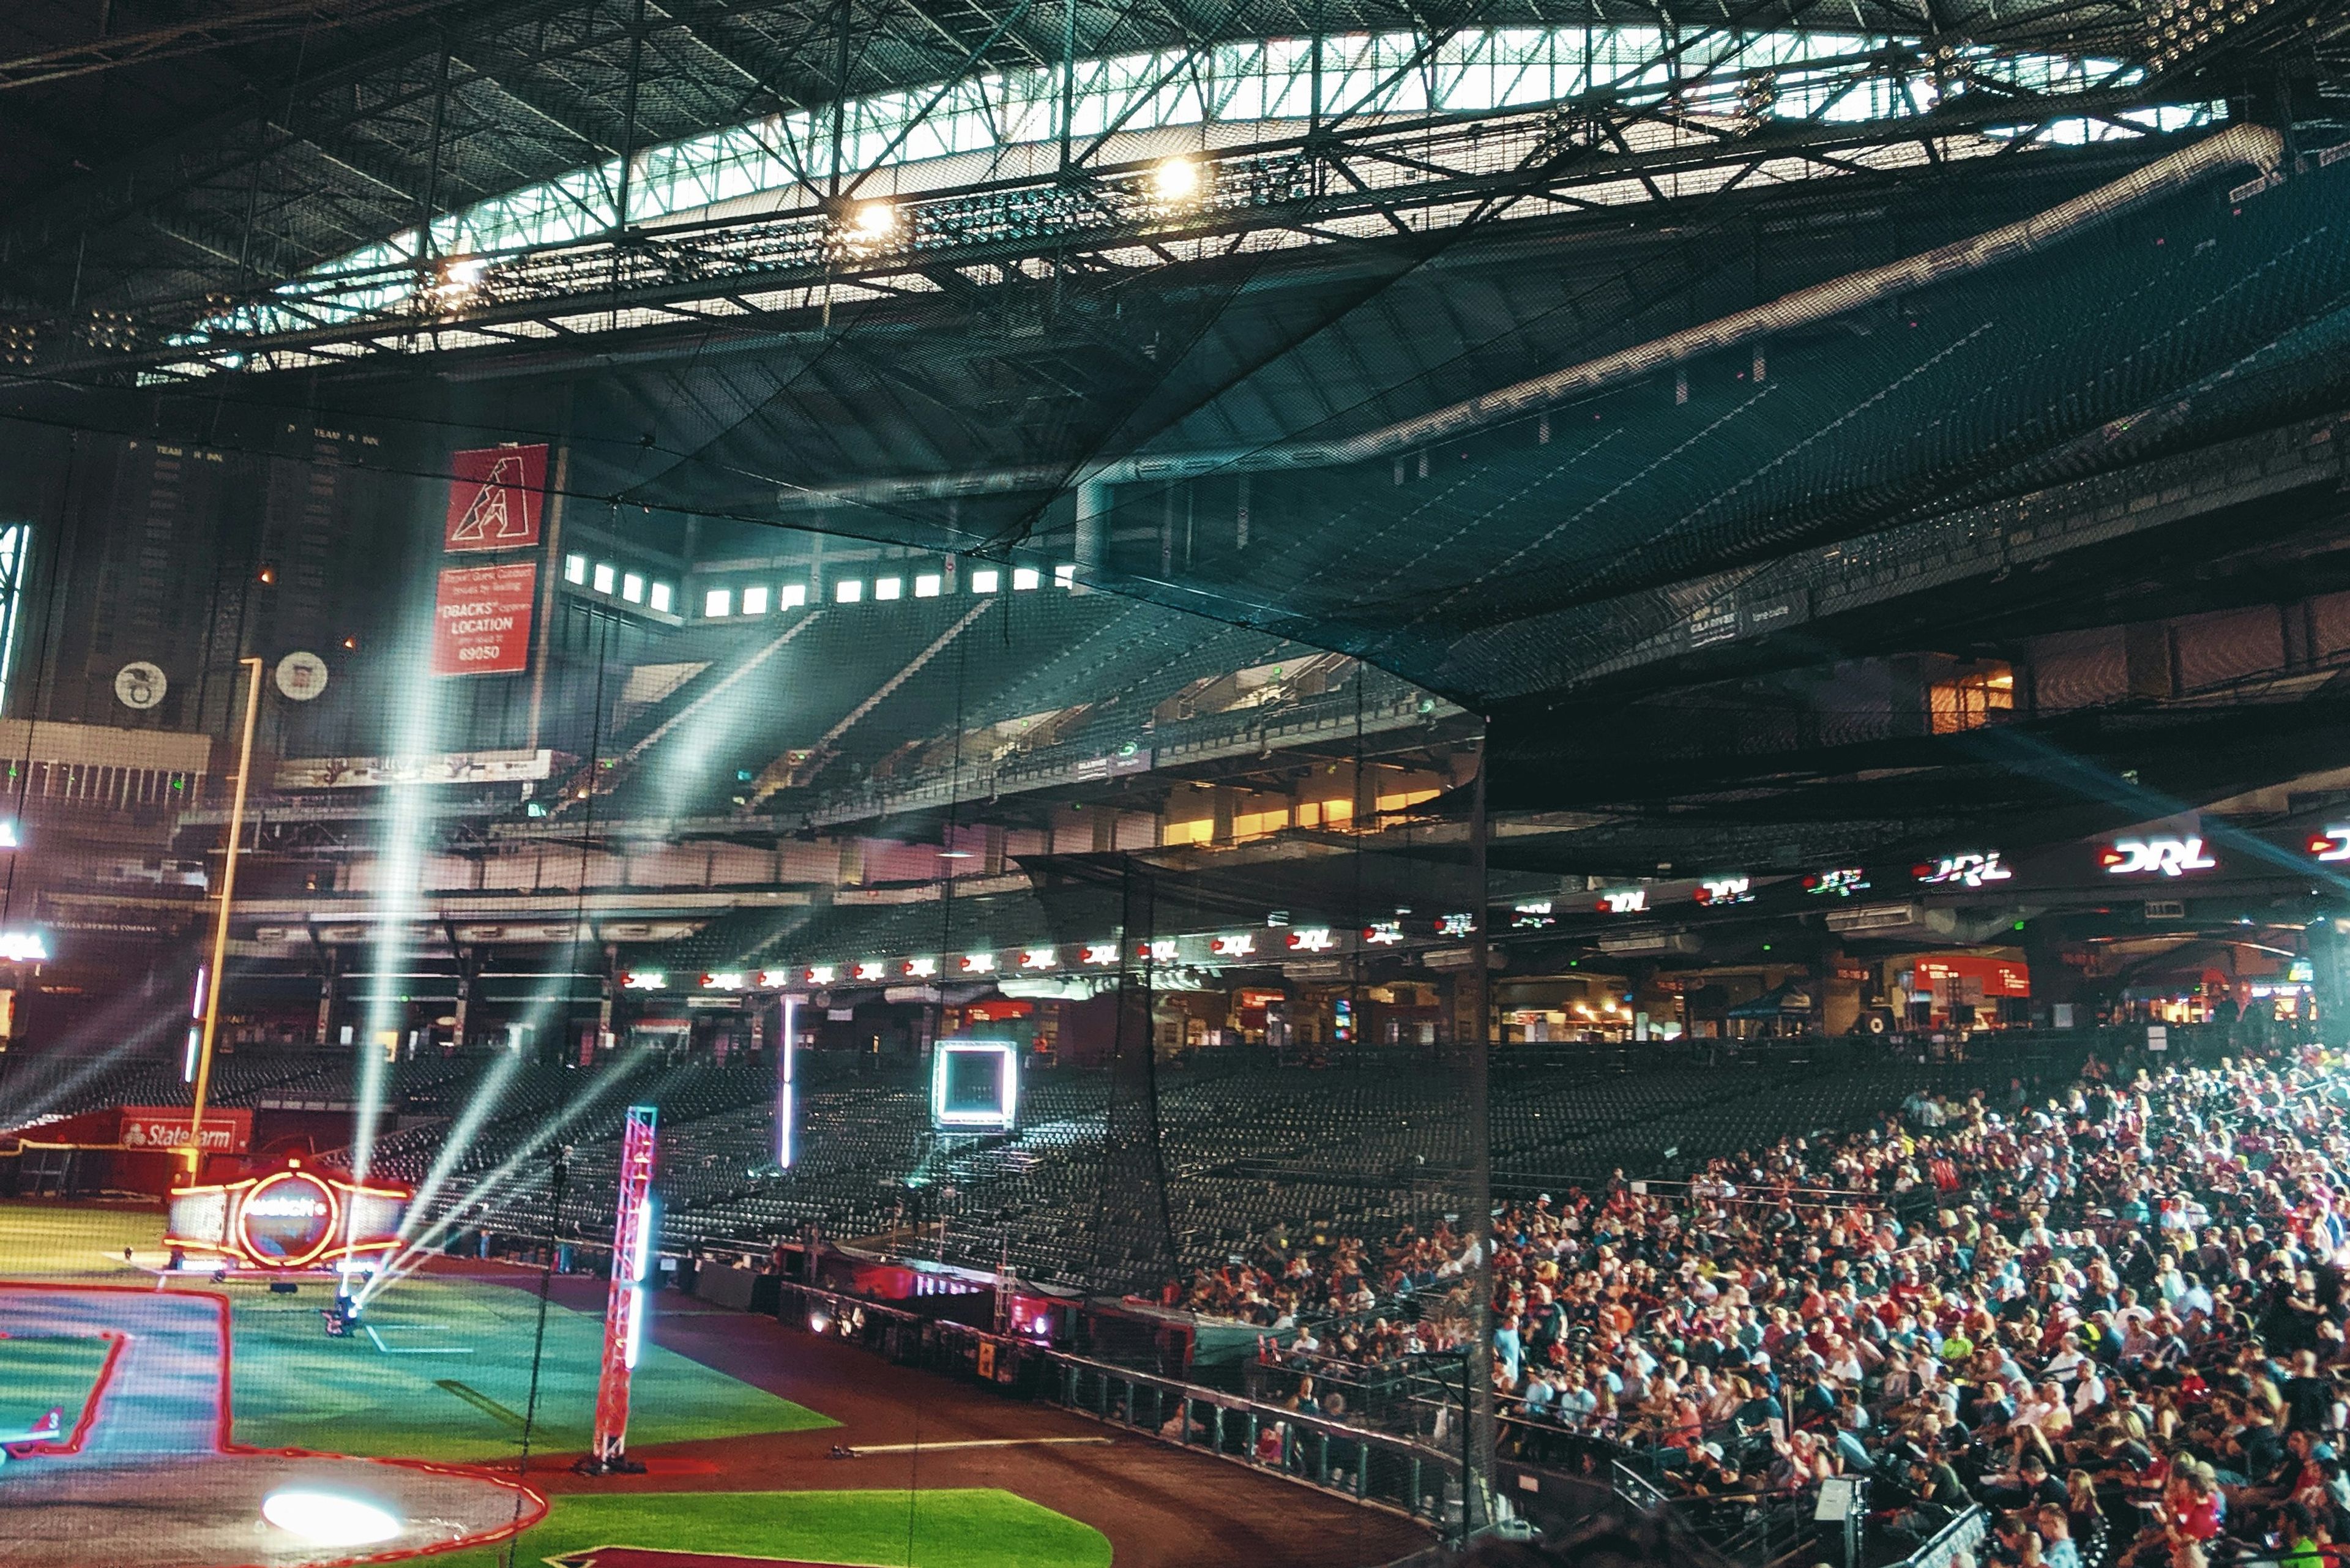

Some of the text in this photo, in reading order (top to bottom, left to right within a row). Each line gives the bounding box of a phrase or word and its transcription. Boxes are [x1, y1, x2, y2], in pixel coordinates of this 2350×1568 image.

[313, 428, 341, 440] TEAM
[156, 445, 183, 457] TEAM
[451, 617, 513, 634] LOCATION
[459, 646, 500, 661] 69050
[2109, 839, 2215, 876] DRL
[1918, 852, 2012, 886] DRL
[48, 1412, 59, 1429] 3
